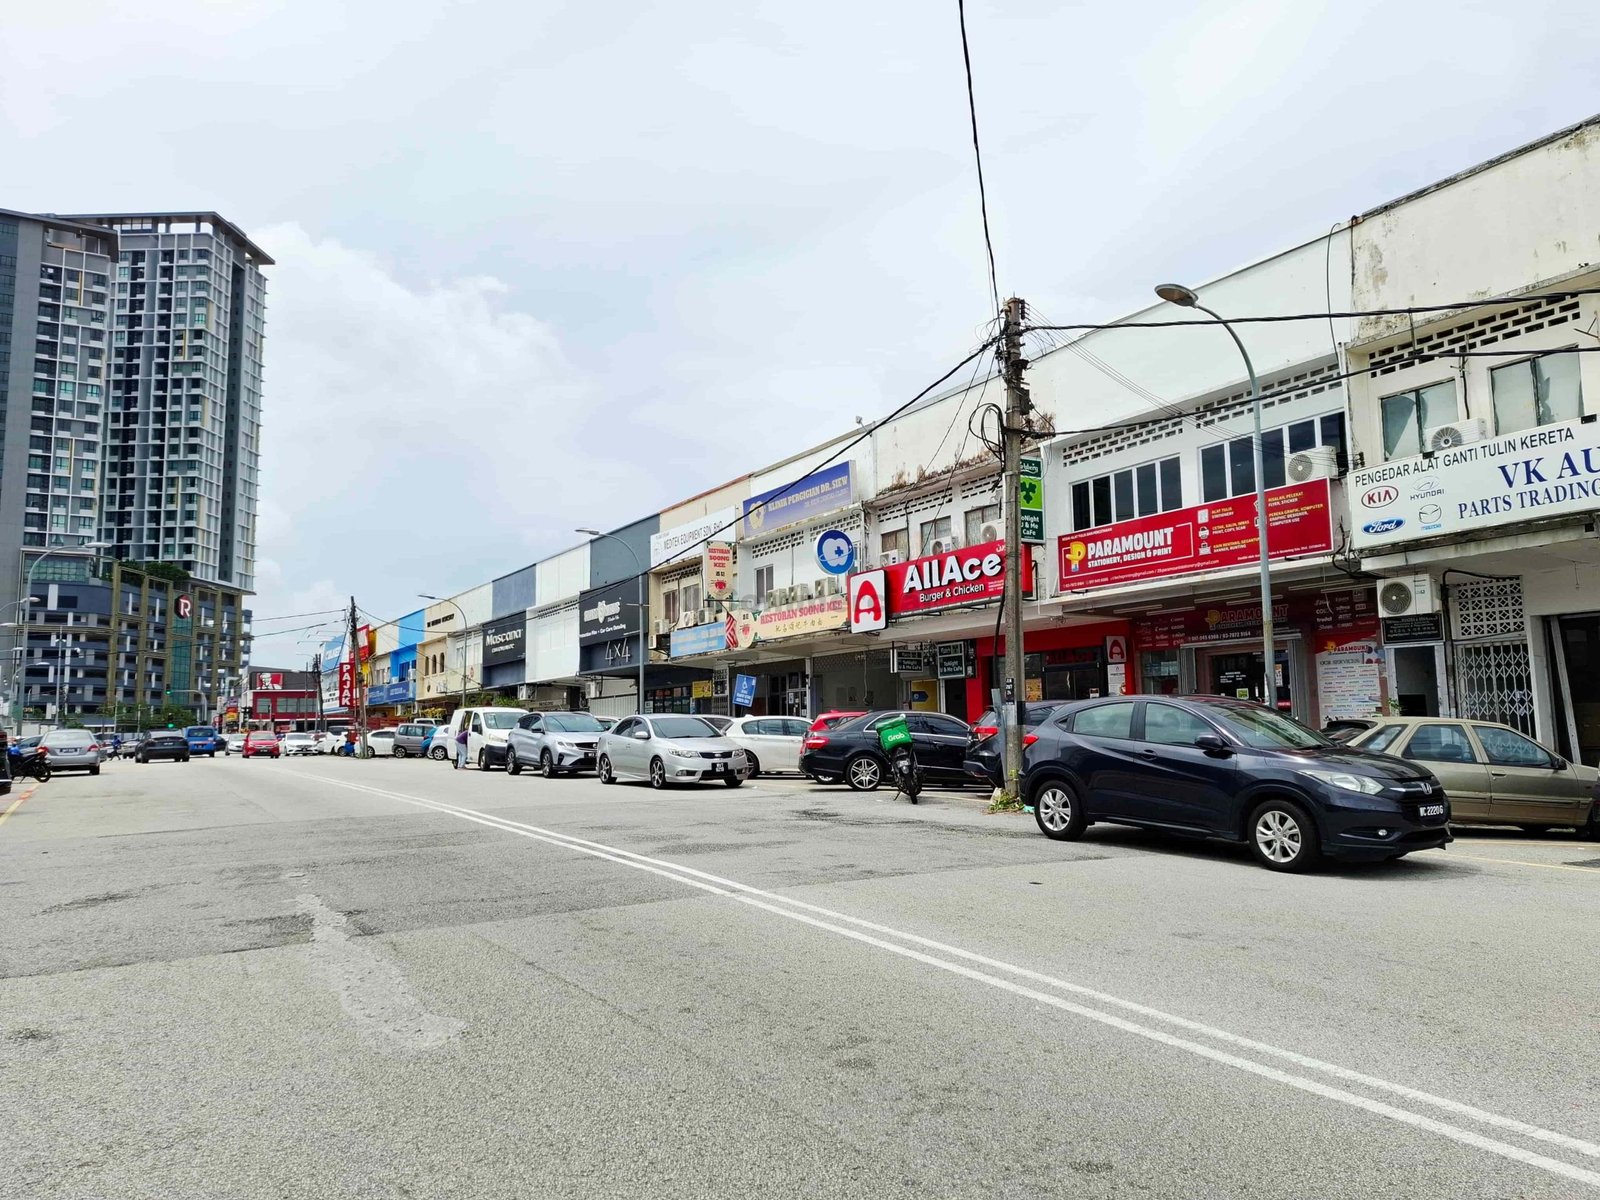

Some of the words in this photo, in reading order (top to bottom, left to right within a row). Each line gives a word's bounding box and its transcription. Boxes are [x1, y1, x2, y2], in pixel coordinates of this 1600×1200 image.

[1355, 463, 1410, 487] PENGEDAR
[1413, 457, 1439, 476] ALAT
[1443, 448, 1478, 467] GANTI
[1481, 439, 1517, 458] TULIN
[1520, 427, 1575, 450] KERETA
[1497, 457, 1548, 489] VK
[1367, 489, 1393, 505] KIA
[1410, 488, 1445, 500] HYUNDAI
[1458, 494, 1512, 519] PARTS
[1020, 514, 1039, 523] oNight
[1368, 519, 1398, 533] Ford
[1087, 526, 1174, 560] PARAMOUNT
[1087, 555, 1123, 569] STATIONERY,
[1123, 551, 1146, 562] DESIGN
[1152, 546, 1173, 557] PRINT
[903, 552, 1002, 593] AllAce
[919, 588, 944, 603] Burger
[945, 588, 951, 598] &
[953, 583, 985, 596] Chicken
[760, 609, 797, 626] RESTORAN
[799, 603, 825, 618] SOONG
[341, 664, 352, 706] PAJAK
[887, 732, 905, 742] Grab
